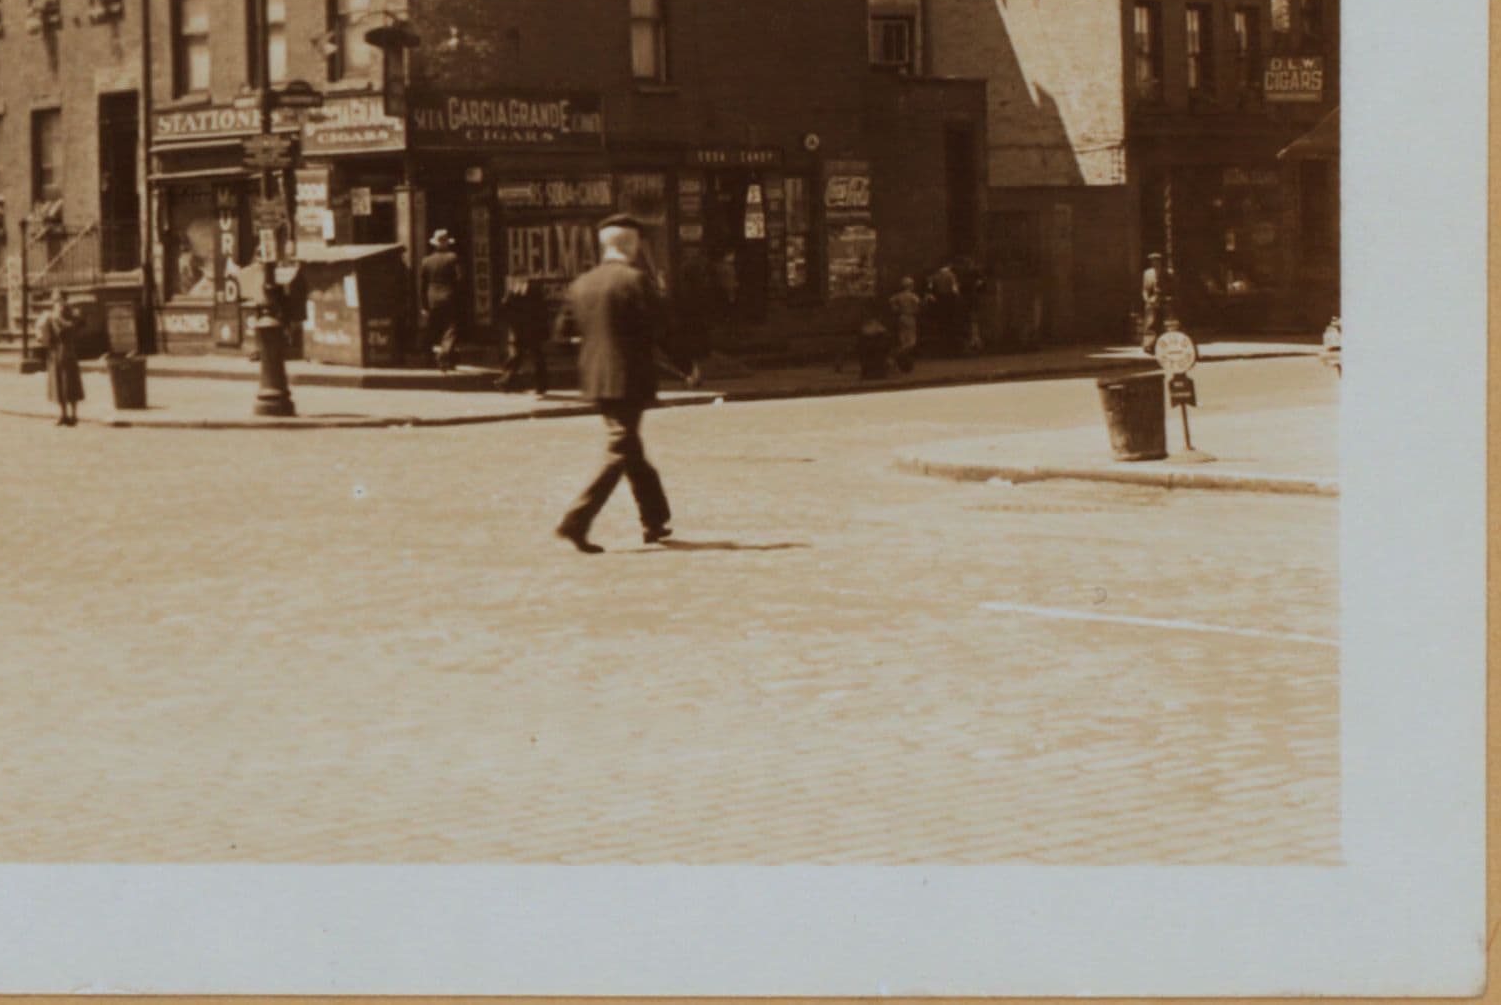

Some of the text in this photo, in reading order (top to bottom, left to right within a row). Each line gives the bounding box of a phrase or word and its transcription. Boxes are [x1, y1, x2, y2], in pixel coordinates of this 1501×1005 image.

[1264, 70, 1323, 91] CIGARS
[447, 96, 508, 131] GARCIA
[508, 98, 571, 133] GRANDE
[317, 130, 390, 144] CIGARS
[464, 129, 554, 142] CIGARS
